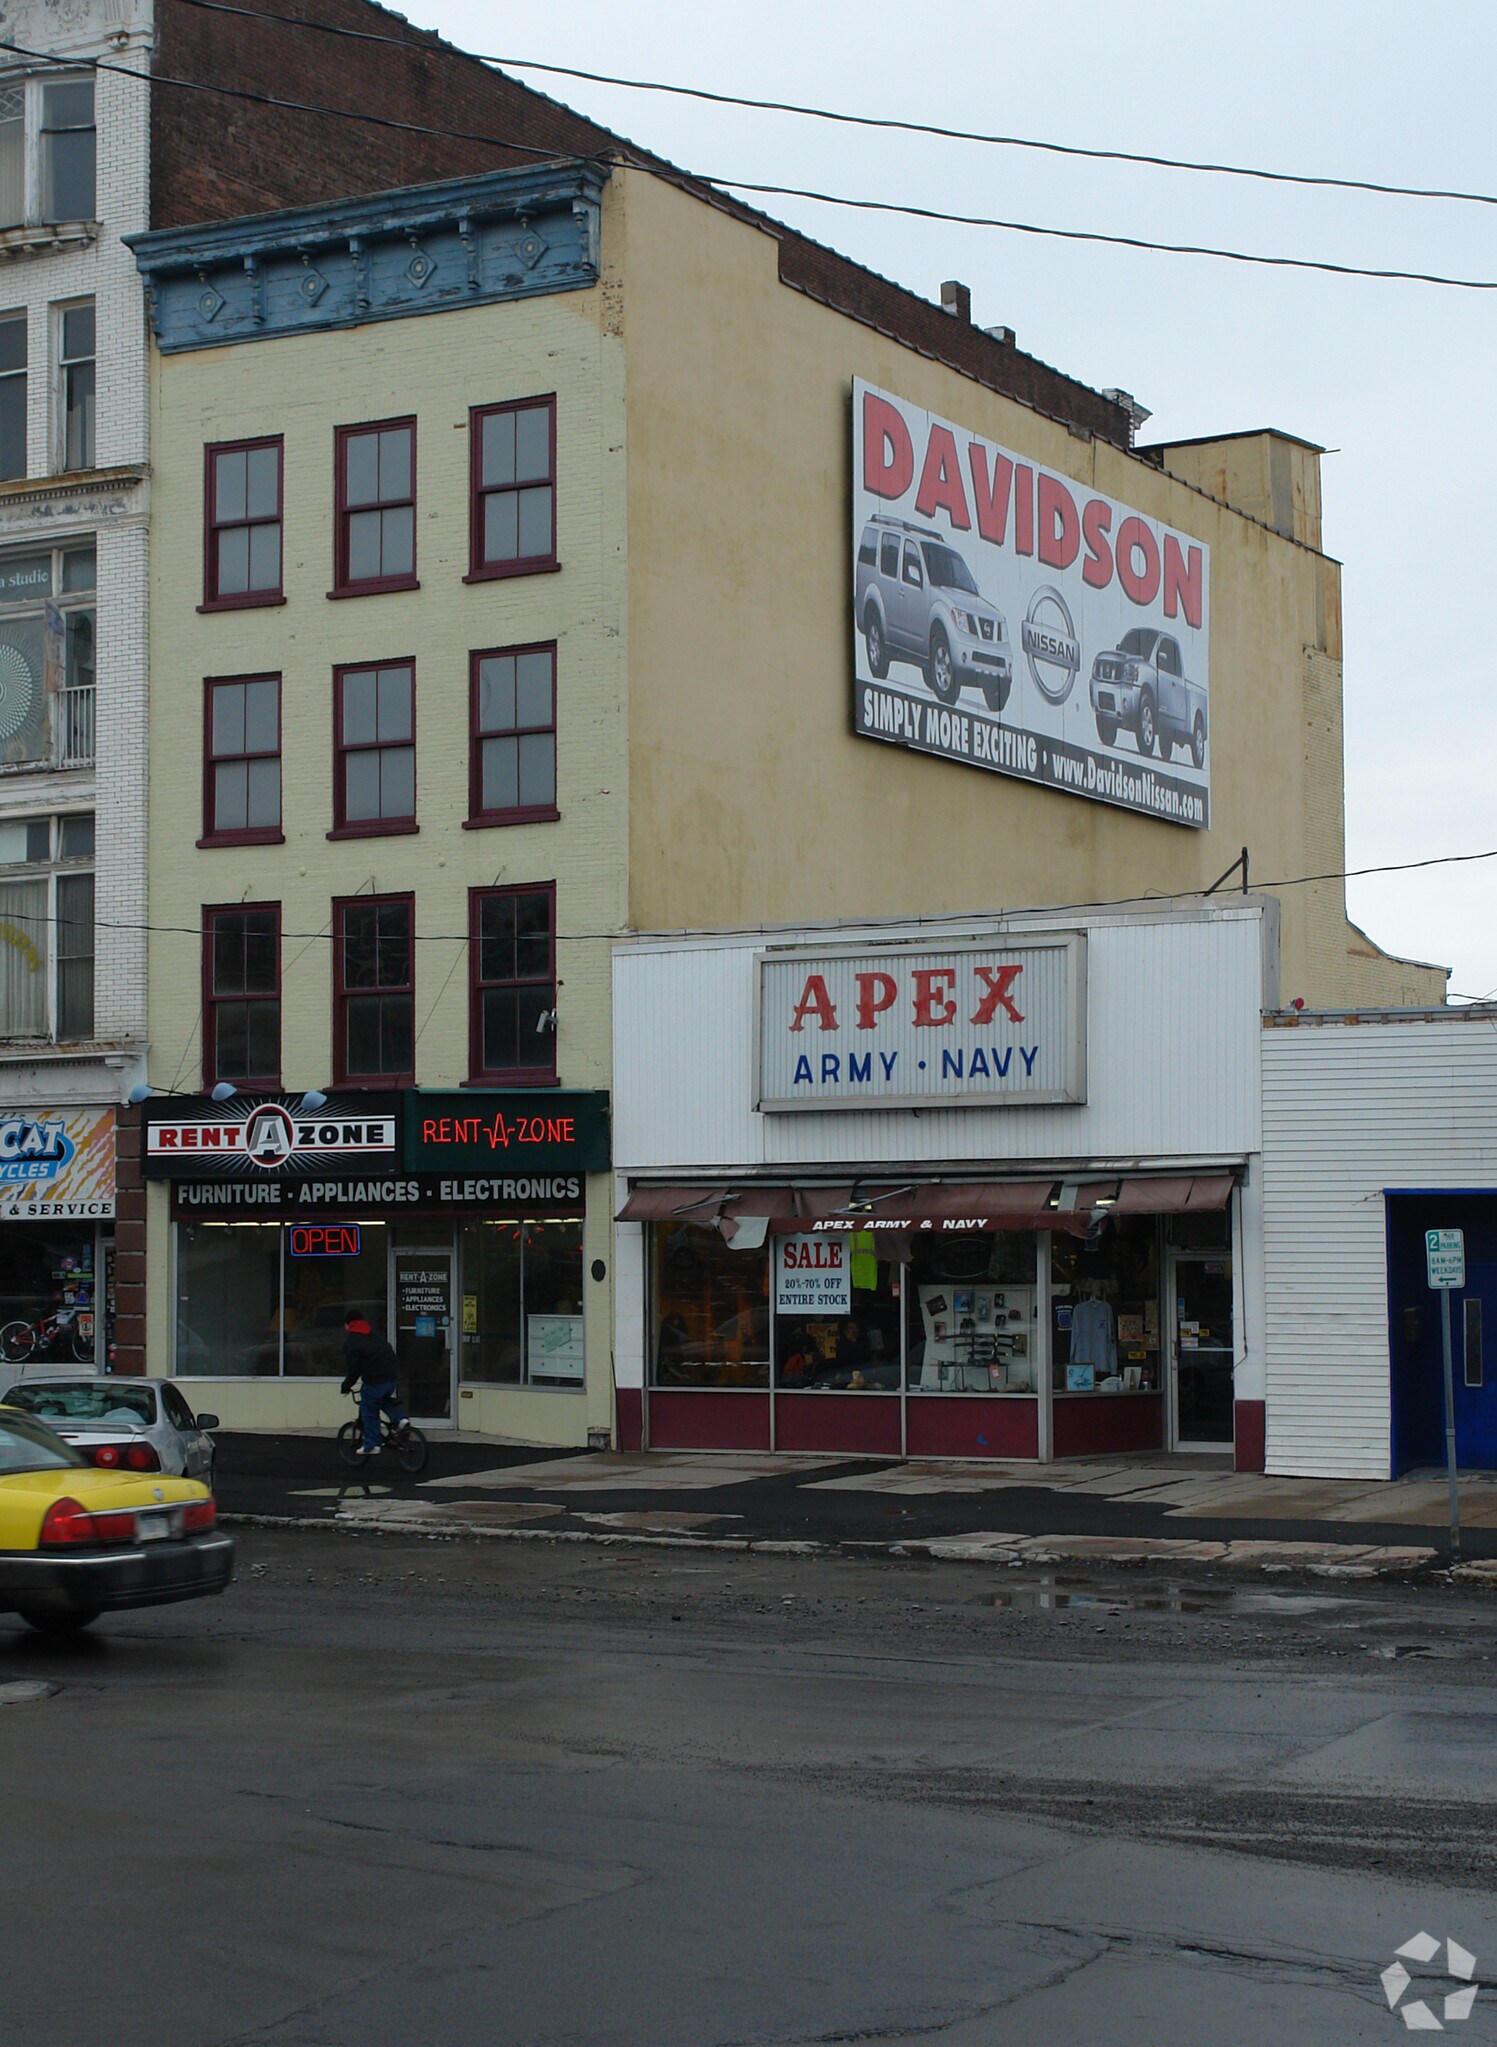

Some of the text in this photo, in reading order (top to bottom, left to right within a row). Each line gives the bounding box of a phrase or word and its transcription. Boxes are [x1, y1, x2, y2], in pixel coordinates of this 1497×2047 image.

[863, 391, 1203, 629] DAVIDSON
[8, 569, 49, 586] studio
[1027, 629, 1076, 663] NISSAN
[864, 688, 1204, 822] SIMPLY MORE EXCITING www.DavidsonNissan.com
[788, 965, 1025, 1032] APEX
[793, 1046, 1039, 1084] ARMY NAVY
[159, 1115, 384, 1156] RENT A ZONE
[178, 1177, 580, 1204] FURNITURE APPLIANCES ELECTRONICS
[9, 1202, 113, 1216] & SERVICE
[812, 1218, 988, 1231] APEX ARMY & NAVY
[291, 1227, 359, 1254] OPEN
[1429, 1235, 1438, 1248] 2
[783, 1241, 843, 1270] SALE
[785, 1277, 842, 1289] 20%-70% OFF
[779, 1294, 848, 1305] ENTIRE STOCK
